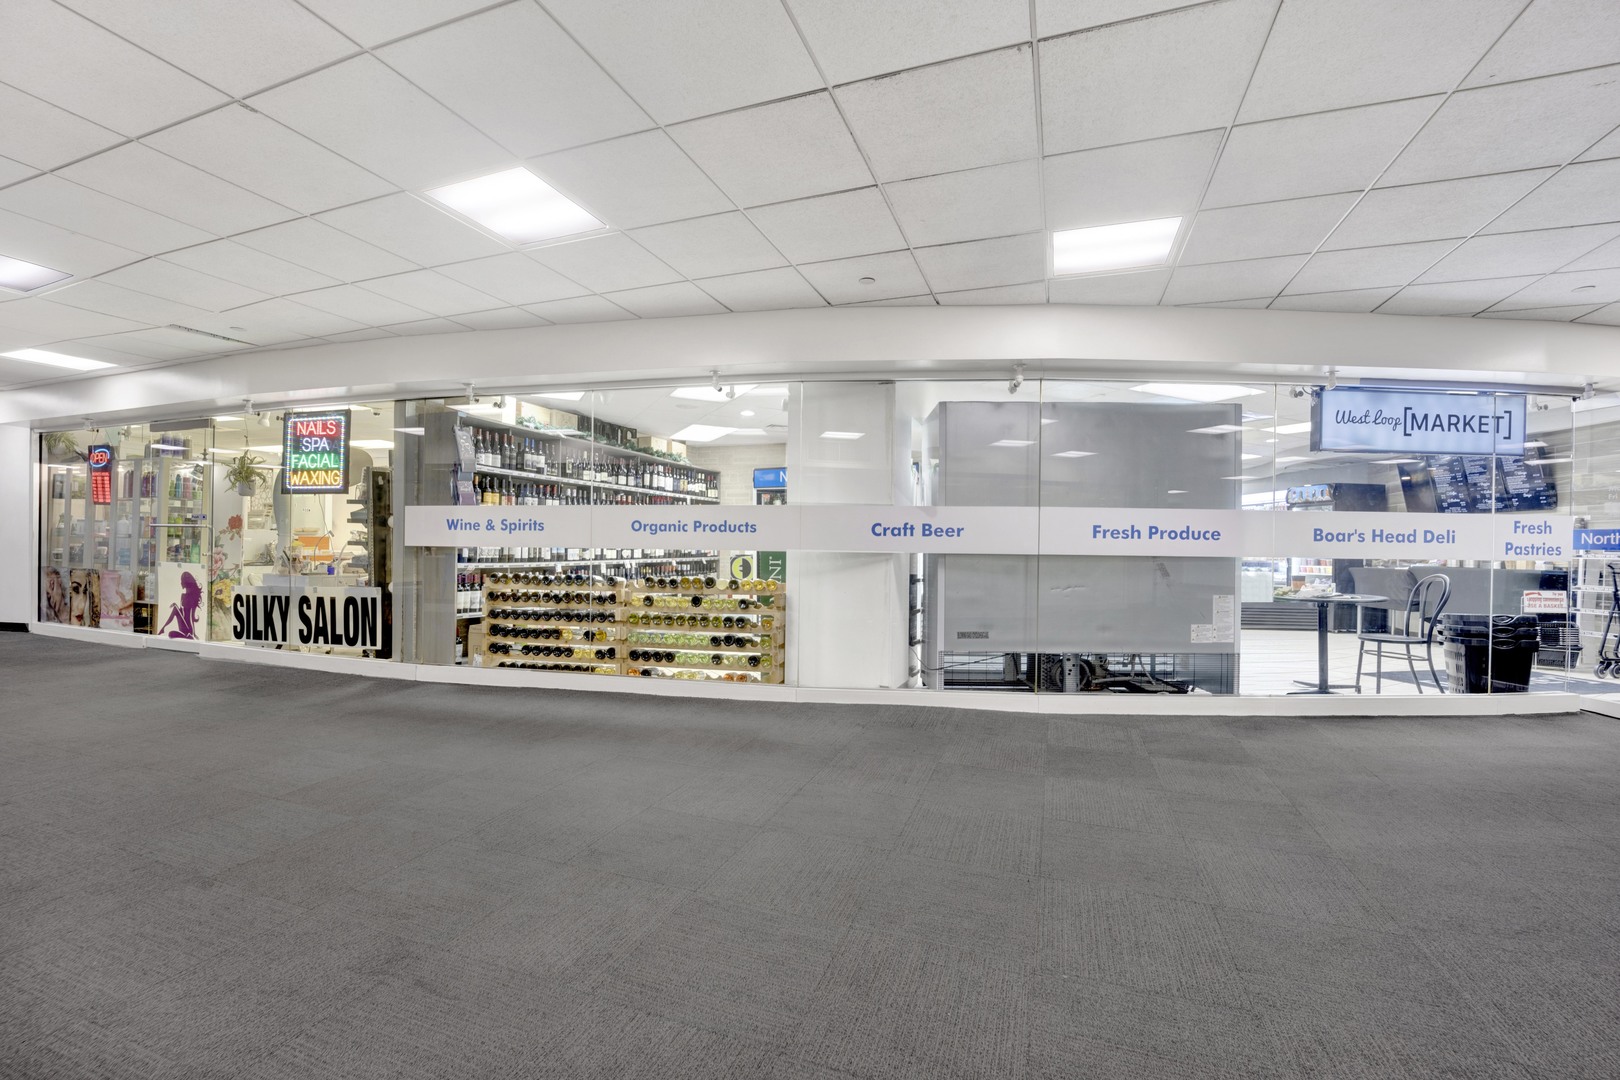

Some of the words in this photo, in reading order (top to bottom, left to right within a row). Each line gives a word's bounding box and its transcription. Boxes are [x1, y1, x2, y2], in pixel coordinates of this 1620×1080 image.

[1335, 409, 1371, 425] West
[296, 420, 336, 435] NAILS
[302, 437, 329, 452] SPA
[90, 452, 108, 464] OPEN
[291, 453, 338, 469] FACIAL
[290, 470, 340, 486] WAXING
[446, 518, 481, 531] Wine
[486, 519, 496, 531] &
[500, 518, 545, 534] Spirits
[631, 519, 688, 536] Organic
[693, 519, 757, 534] Products
[871, 522, 915, 538] Craft
[922, 523, 965, 538] Beer
[1092, 524, 1142, 540] Fresh
[1148, 525, 1221, 541] Produce
[1513, 520, 1552, 535] Fresh
[1313, 527, 1366, 544] Boar's
[1371, 528, 1418, 544] Head
[1423, 528, 1456, 544] Deli
[1505, 542, 1562, 556] Pastries
[233, 593, 290, 643] SILKY
[298, 595, 378, 647] SALON
